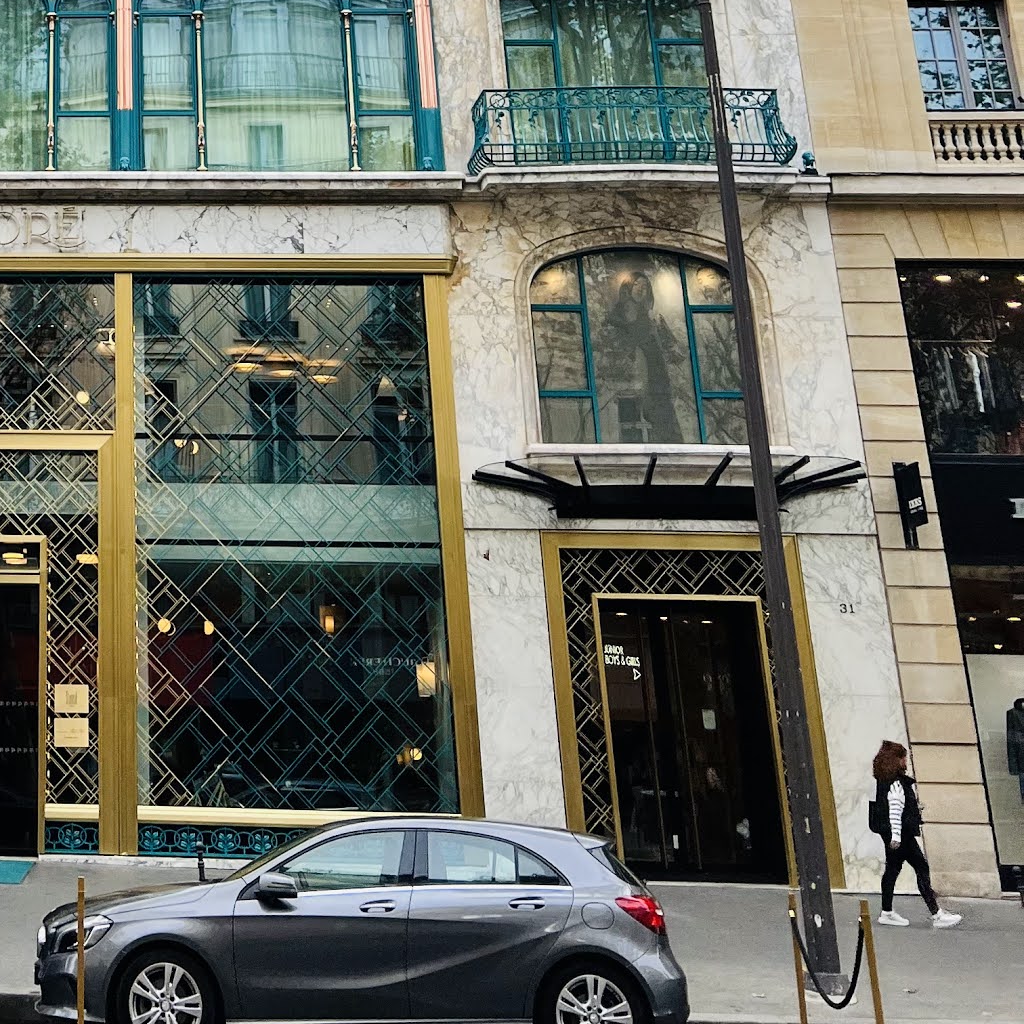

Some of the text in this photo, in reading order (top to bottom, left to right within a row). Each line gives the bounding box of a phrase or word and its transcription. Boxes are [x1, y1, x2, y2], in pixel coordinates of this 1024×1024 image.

[839, 603, 855, 614] 31
[604, 655, 620, 666] BOYS
[621, 656, 626, 666] &
